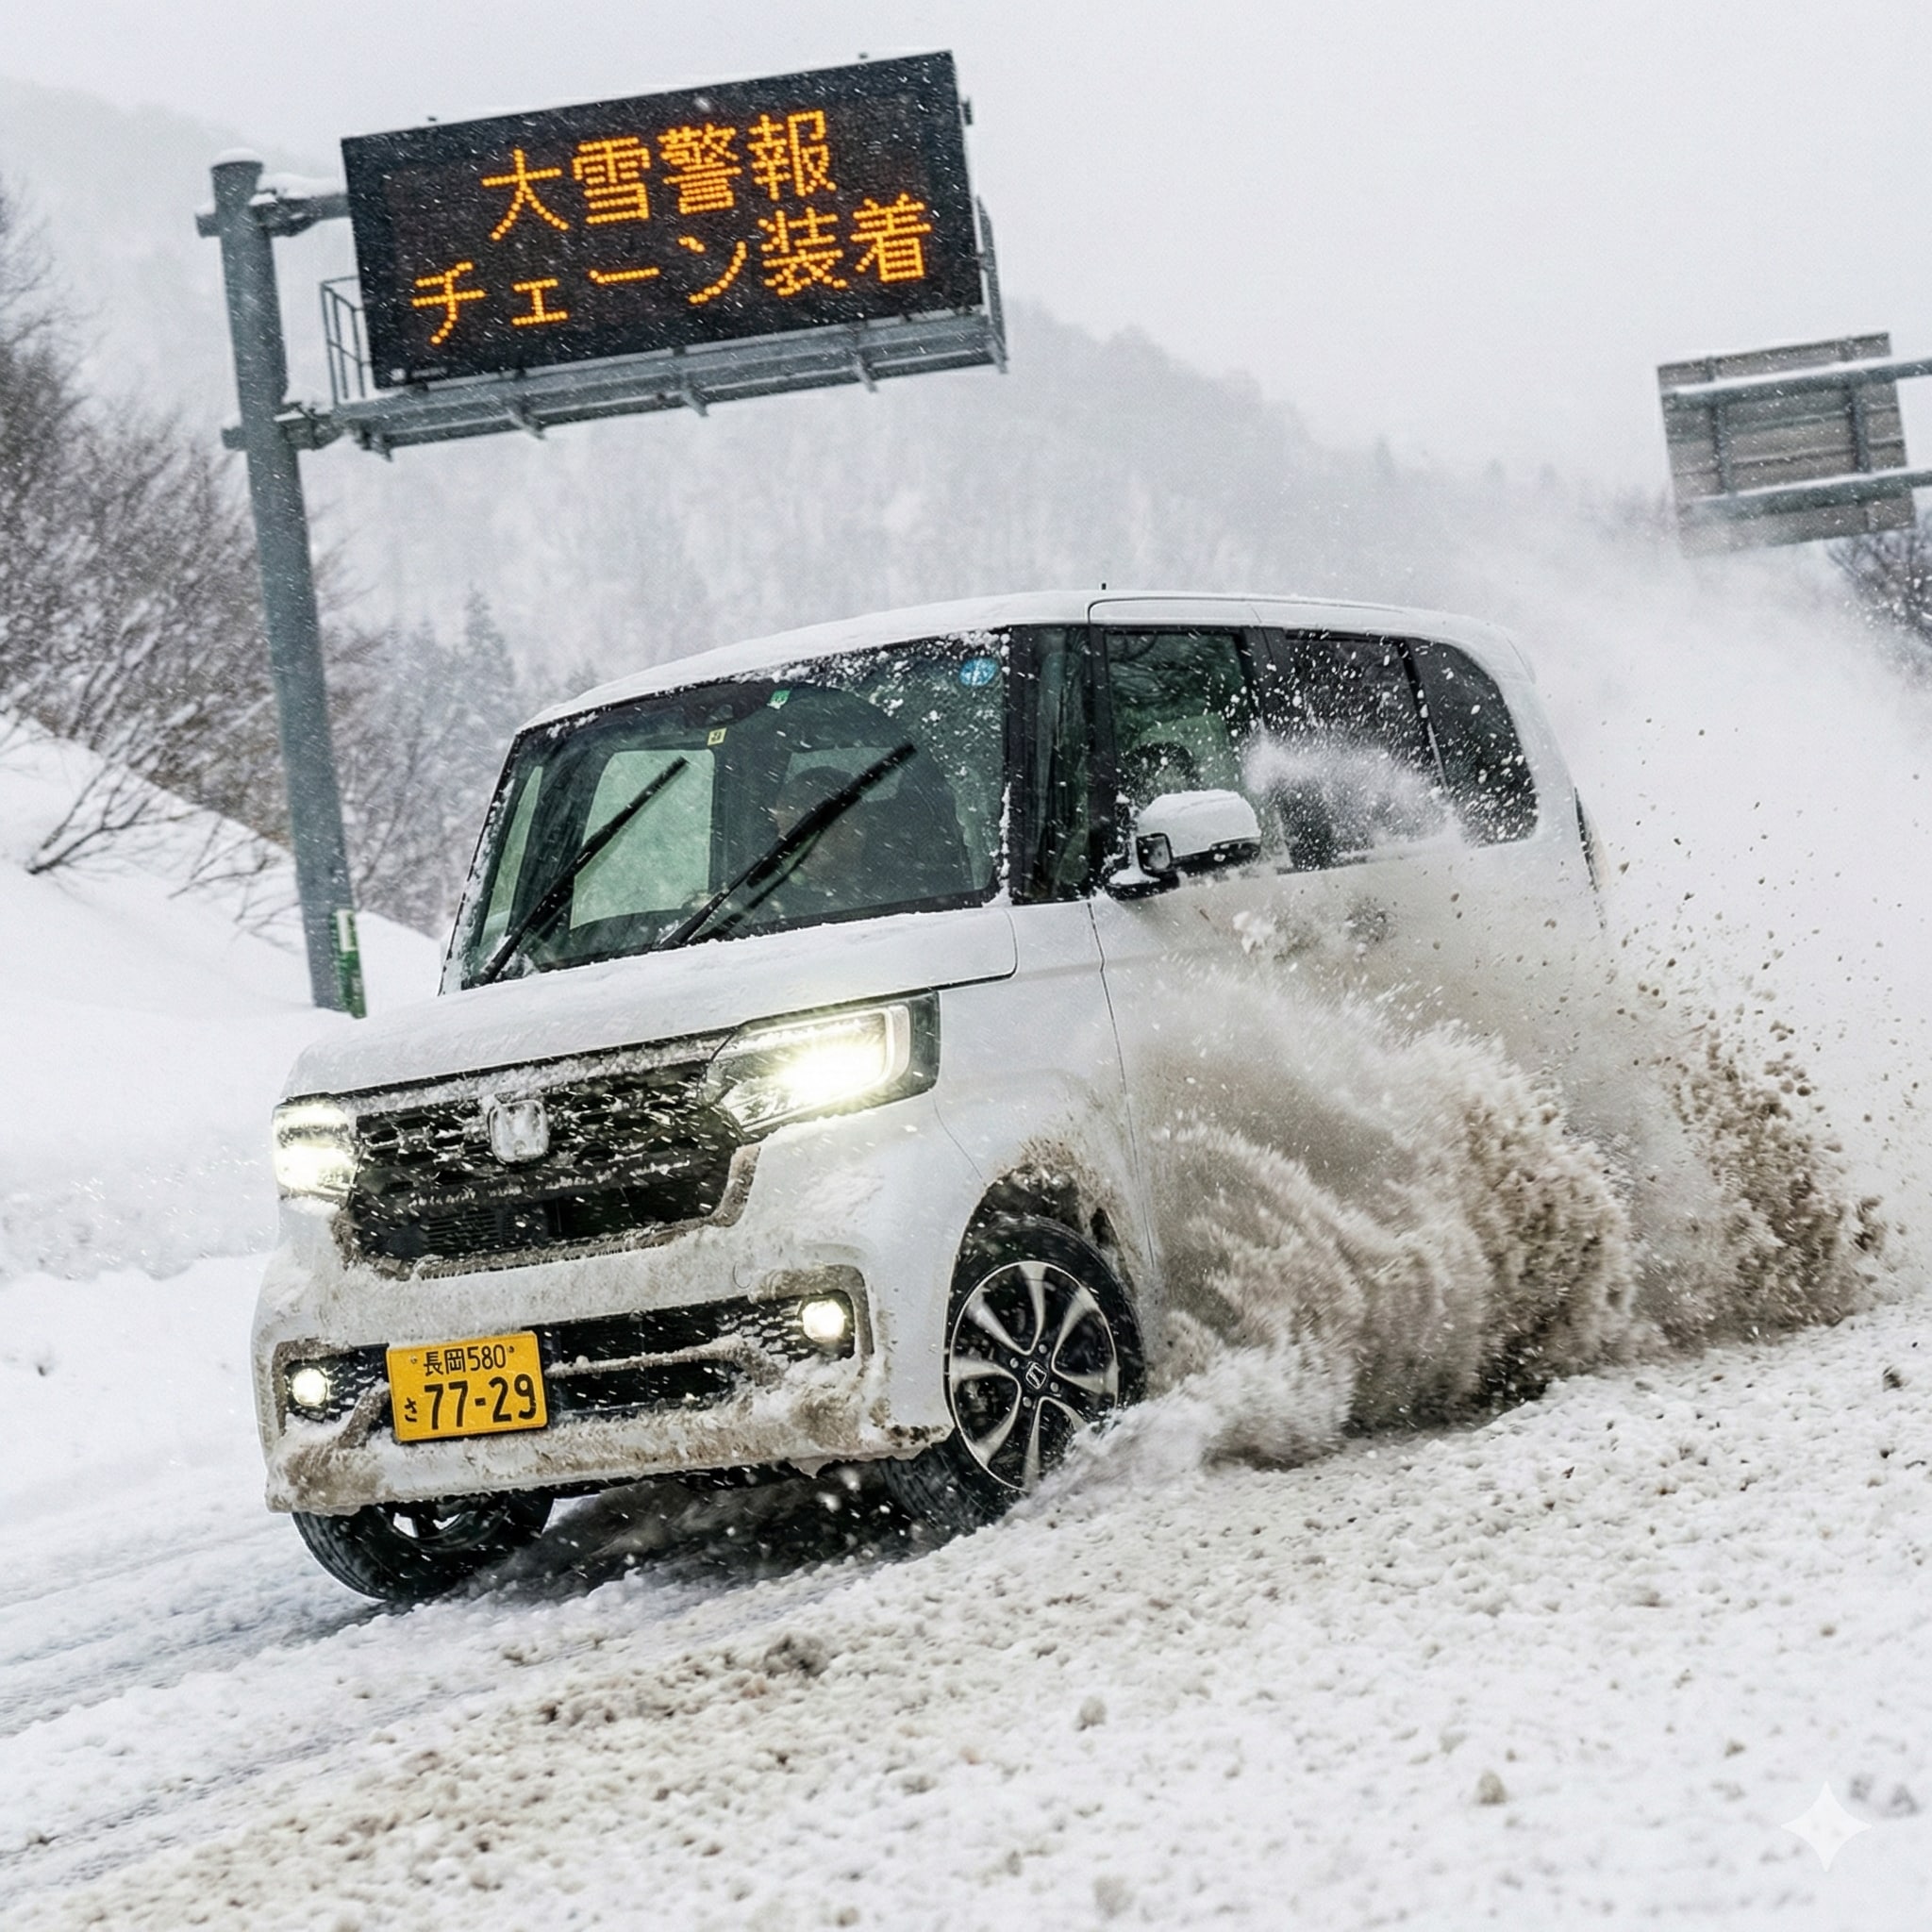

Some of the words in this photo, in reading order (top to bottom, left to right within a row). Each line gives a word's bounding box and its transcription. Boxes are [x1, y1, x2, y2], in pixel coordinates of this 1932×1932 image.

[481, 110, 837, 241] 大雪警報
[411, 192, 932, 344] チェーン装着
[404, 1397, 417, 1423] さ
[424, 1374, 537, 1430] 77-29
[424, 1344, 506, 1376] 長岡580
